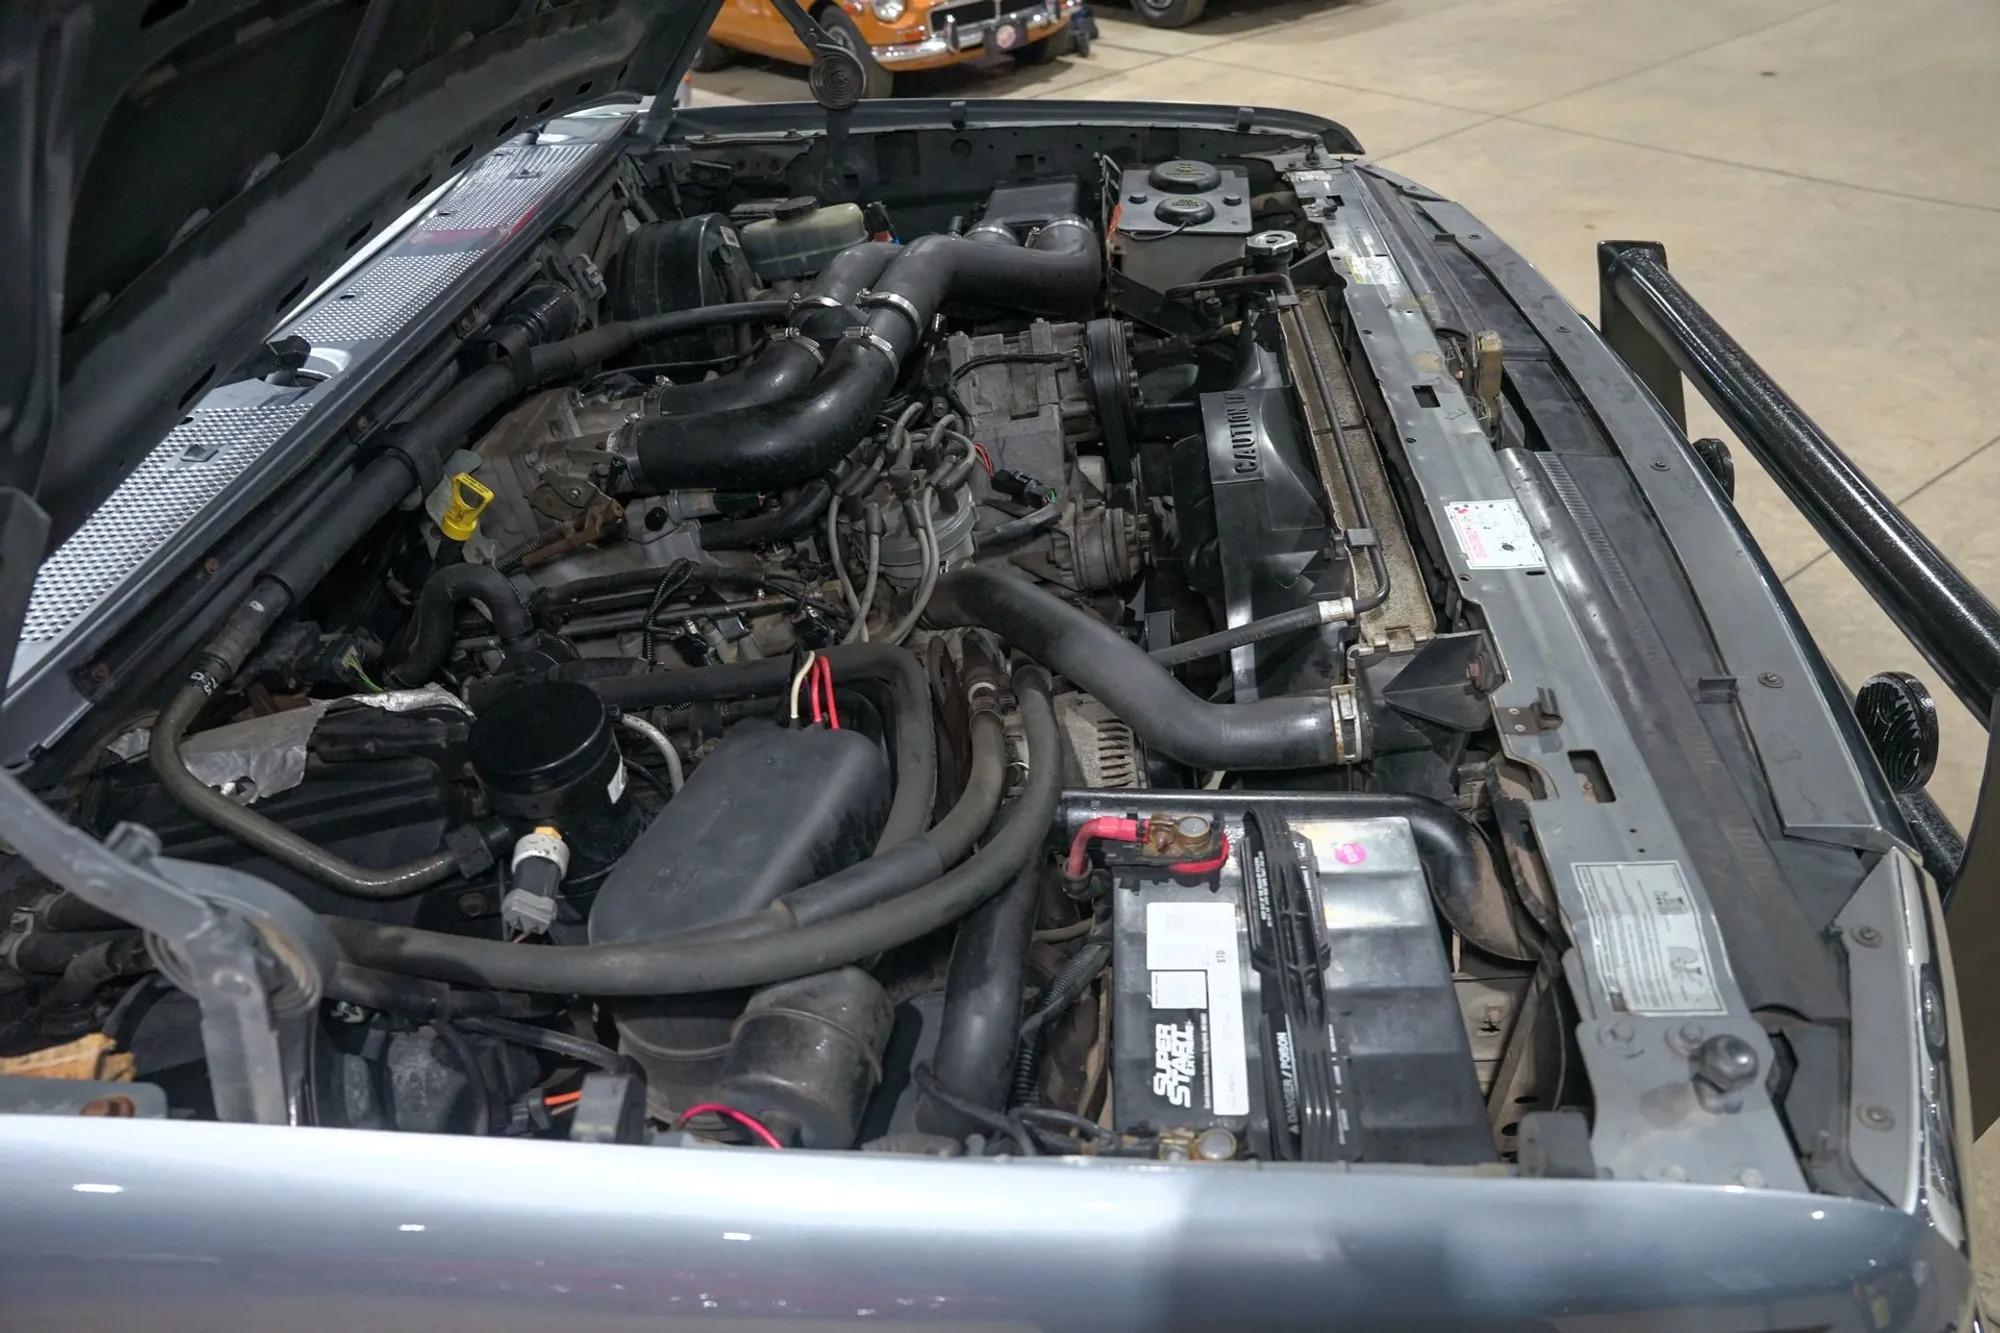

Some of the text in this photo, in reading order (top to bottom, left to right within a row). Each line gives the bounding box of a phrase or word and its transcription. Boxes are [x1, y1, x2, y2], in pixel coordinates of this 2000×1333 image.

[1226, 408, 1257, 474] CAUTION
[1153, 1024, 1172, 1096] SUPER
[1167, 1024, 1192, 1108] START
[1276, 1032, 1291, 1070] POISON
[1282, 1079, 1299, 1124] DANGER
